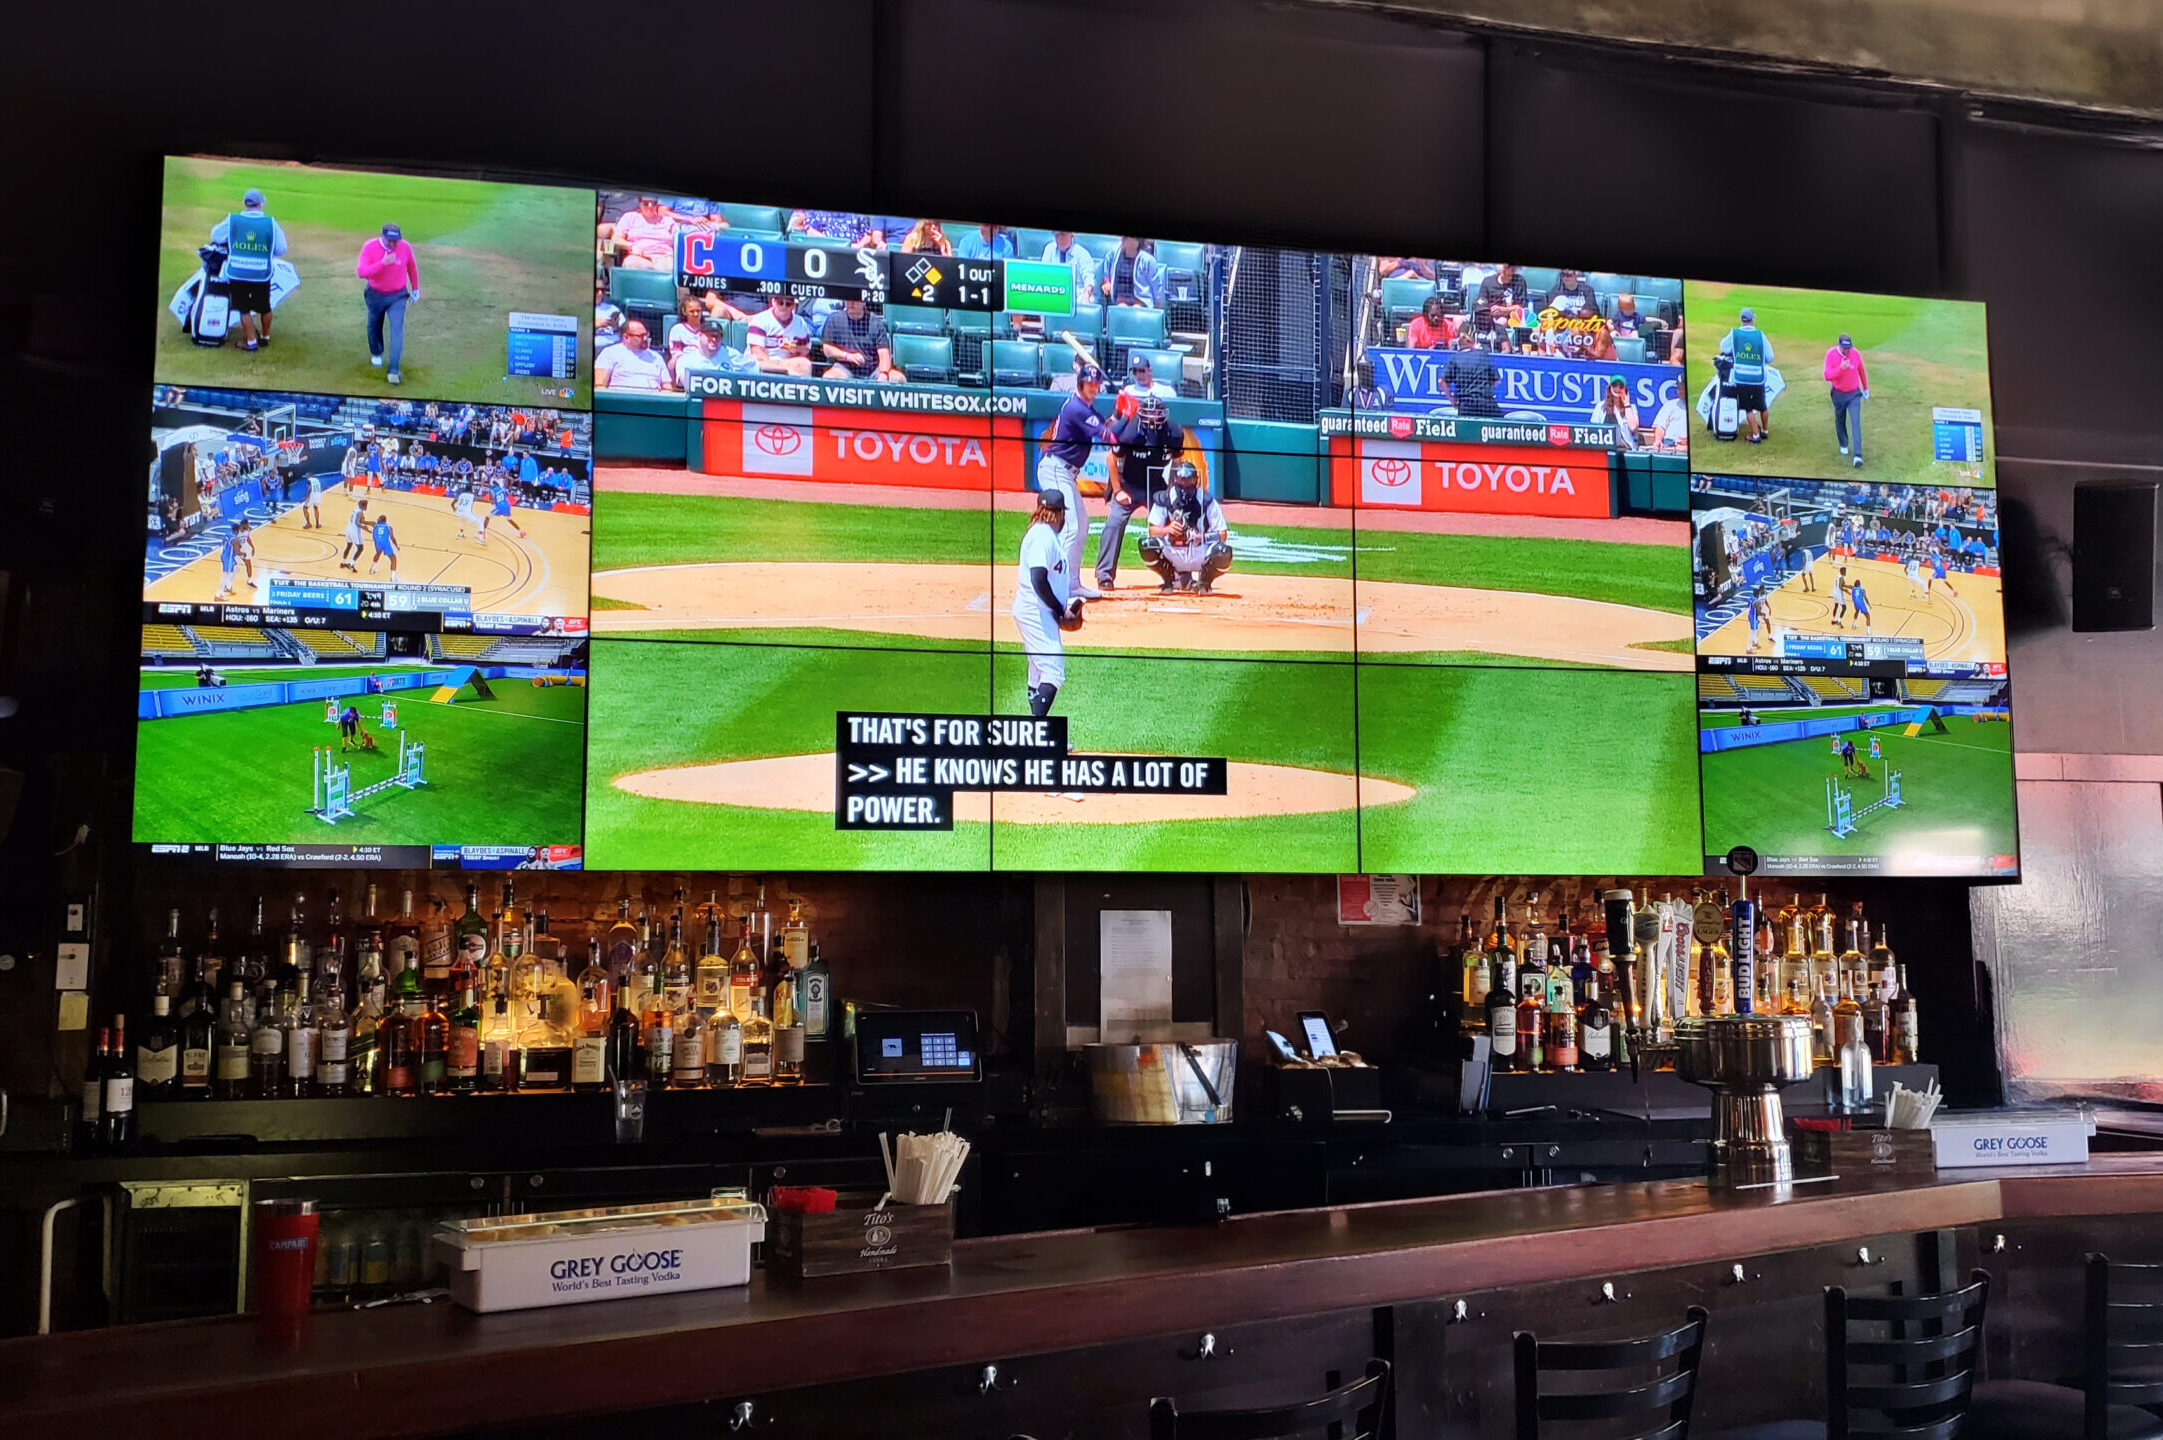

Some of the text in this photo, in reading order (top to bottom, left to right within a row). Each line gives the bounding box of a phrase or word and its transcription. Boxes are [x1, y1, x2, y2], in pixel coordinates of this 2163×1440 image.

[684, 233, 715, 275] C
[740, 243, 763, 273] 0
[804, 248, 827, 279] 0
[958, 264, 995, 283] 1 OUT
[682, 276, 727, 289] 7.JONES
[756, 281, 781, 294] .300
[1010, 282, 1066, 295] MENARDS
[790, 284, 825, 297] CUETO
[922, 285, 935, 302] 2
[958, 286, 990, 305] 1-1
[1538, 307, 1608, 333] Sports
[1529, 332, 1594, 347] CHICAGO
[690, 375, 1027, 413] FOR TICKETS VISIT WHITESOX.COM
[1321, 415, 1456, 438] guaranteed Rate Field
[330, 436, 347, 447] sling
[1481, 425, 1614, 445] guaranteed Rate Field
[829, 429, 987, 467] TOYOTA
[1435, 461, 1575, 495] TOYOTA
[428, 585, 466, 593] (SYRACUSE)
[335, 593, 352, 605] 61
[388, 594, 408, 606] 59
[158, 603, 192, 614] ESPN
[262, 607, 295, 615] Mariners
[475, 614, 504, 622] BLAYDES
[509, 616, 539, 624] ASPINALL
[1830, 645, 1843, 656] 61
[1867, 646, 1881, 657] 59
[1708, 656, 1731, 665] ESPN
[182, 694, 224, 706] WINIX
[847, 716, 1056, 747] THAT'S FOR SURE.
[1731, 730, 1761, 742] WINIX
[895, 758, 926, 784] HE
[934, 758, 1017, 785] KNOWS
[1024, 759, 1054, 785] HE
[1062, 760, 1105, 786] HAS
[1111, 761, 1126, 787] A
[1133, 762, 1173, 787] LOT
[1179, 762, 1209, 788] OF
[847, 797, 941, 824] POWER.
[237, 845, 254, 853] Jays
[365, 854, 382, 862] ERA)
[1738, 917, 1751, 999] BUD LIGHT
[1974, 1136, 2048, 1151] GREY GOOSE
[863, 1211, 895, 1226] Tito's
[860, 1245, 898, 1257] Handmade
[550, 1248, 681, 1280] GREY GOOSE
[552, 1271, 680, 1292] World's Best Tasting Vodka
